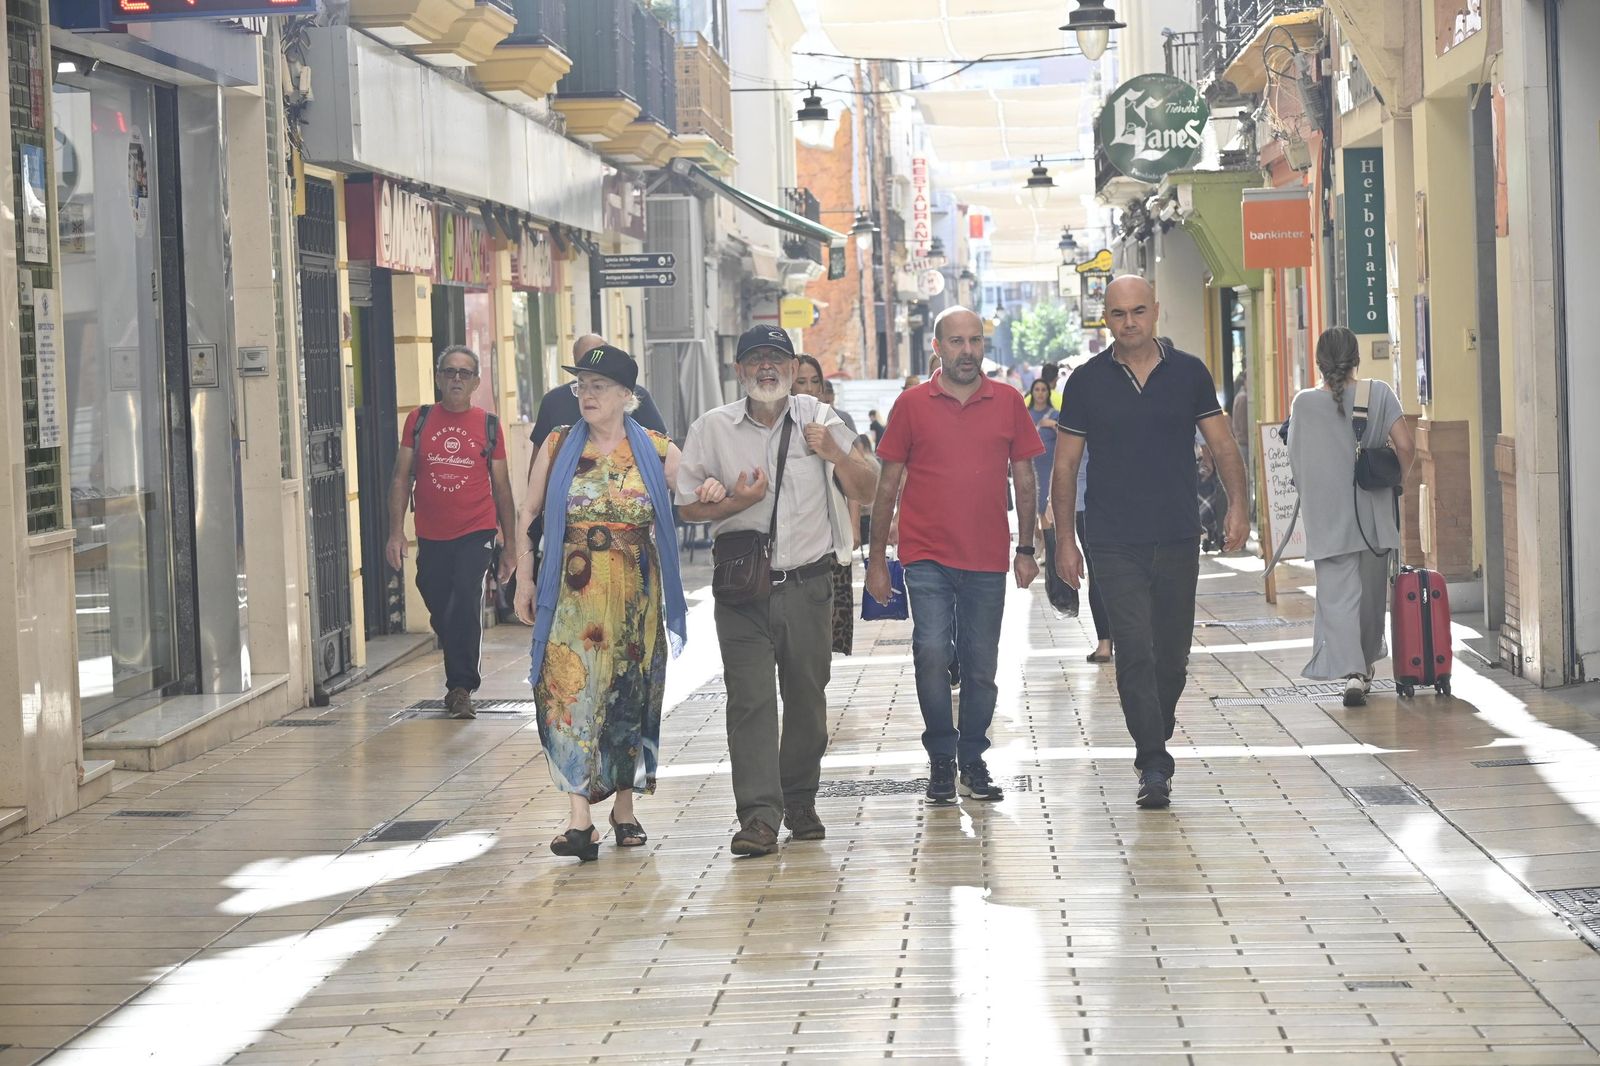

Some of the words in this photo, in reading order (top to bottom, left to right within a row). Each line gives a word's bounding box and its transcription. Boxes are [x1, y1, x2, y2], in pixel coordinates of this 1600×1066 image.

[1165, 100, 1200, 114] Tiendas
[912, 158, 929, 257] RESTAURANTE
[1360, 160, 1377, 321] Herbolario
[431, 426, 467, 441] BREWED
[467, 438, 476, 448] IN
[430, 472, 469, 492] PORTUGAL
